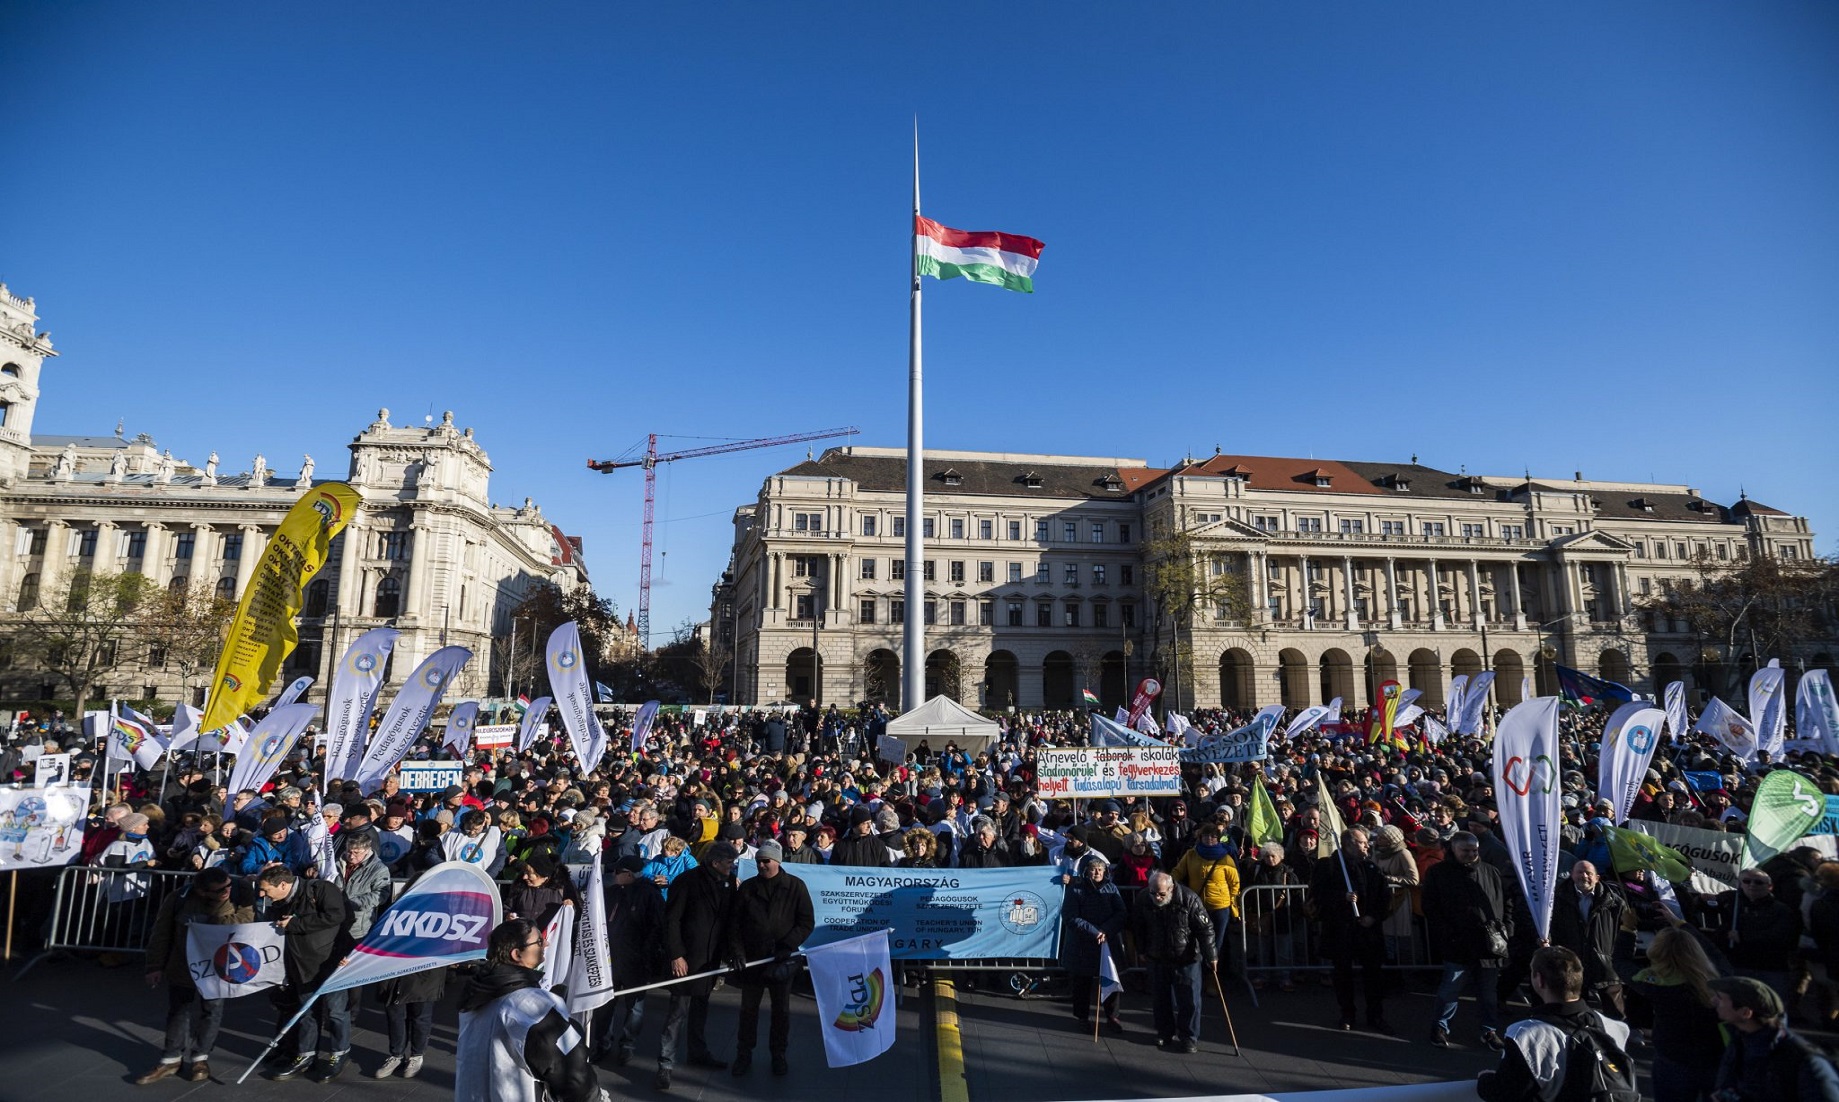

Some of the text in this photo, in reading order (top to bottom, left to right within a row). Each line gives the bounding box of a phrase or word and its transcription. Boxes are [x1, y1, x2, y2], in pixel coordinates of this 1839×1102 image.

[278, 533, 315, 573] OKTATÁS
[567, 692, 590, 742] Pedagógusok
[332, 698, 353, 758] Pedagógusok
[372, 706, 412, 761] Pedagógusok
[384, 704, 428, 766] Szakszervezete
[1095, 749, 1134, 762] táborok
[400, 770, 462, 790] DEBRECEN
[1038, 762, 1098, 778] stadionőrület
[1102, 764, 1114, 776] és
[1038, 777, 1069, 797] helyett
[1073, 775, 1122, 794] tudásalapú
[845, 876, 960, 888] MAGYARORSZÁG
[820, 890, 894, 898] SZAKSZERVEZETEK
[822, 898, 892, 906] EGYÜTTMŰKÖDÉSI
[920, 894, 978, 902] PEDAGÓGUSOK
[380, 910, 488, 944] KKDSZ
[582, 940, 596, 951] ÉS
[891, 940, 944, 949] GARY
[584, 950, 602, 988] SZAKKÉPZÉSI
[848, 972, 875, 1034] PDSZ
